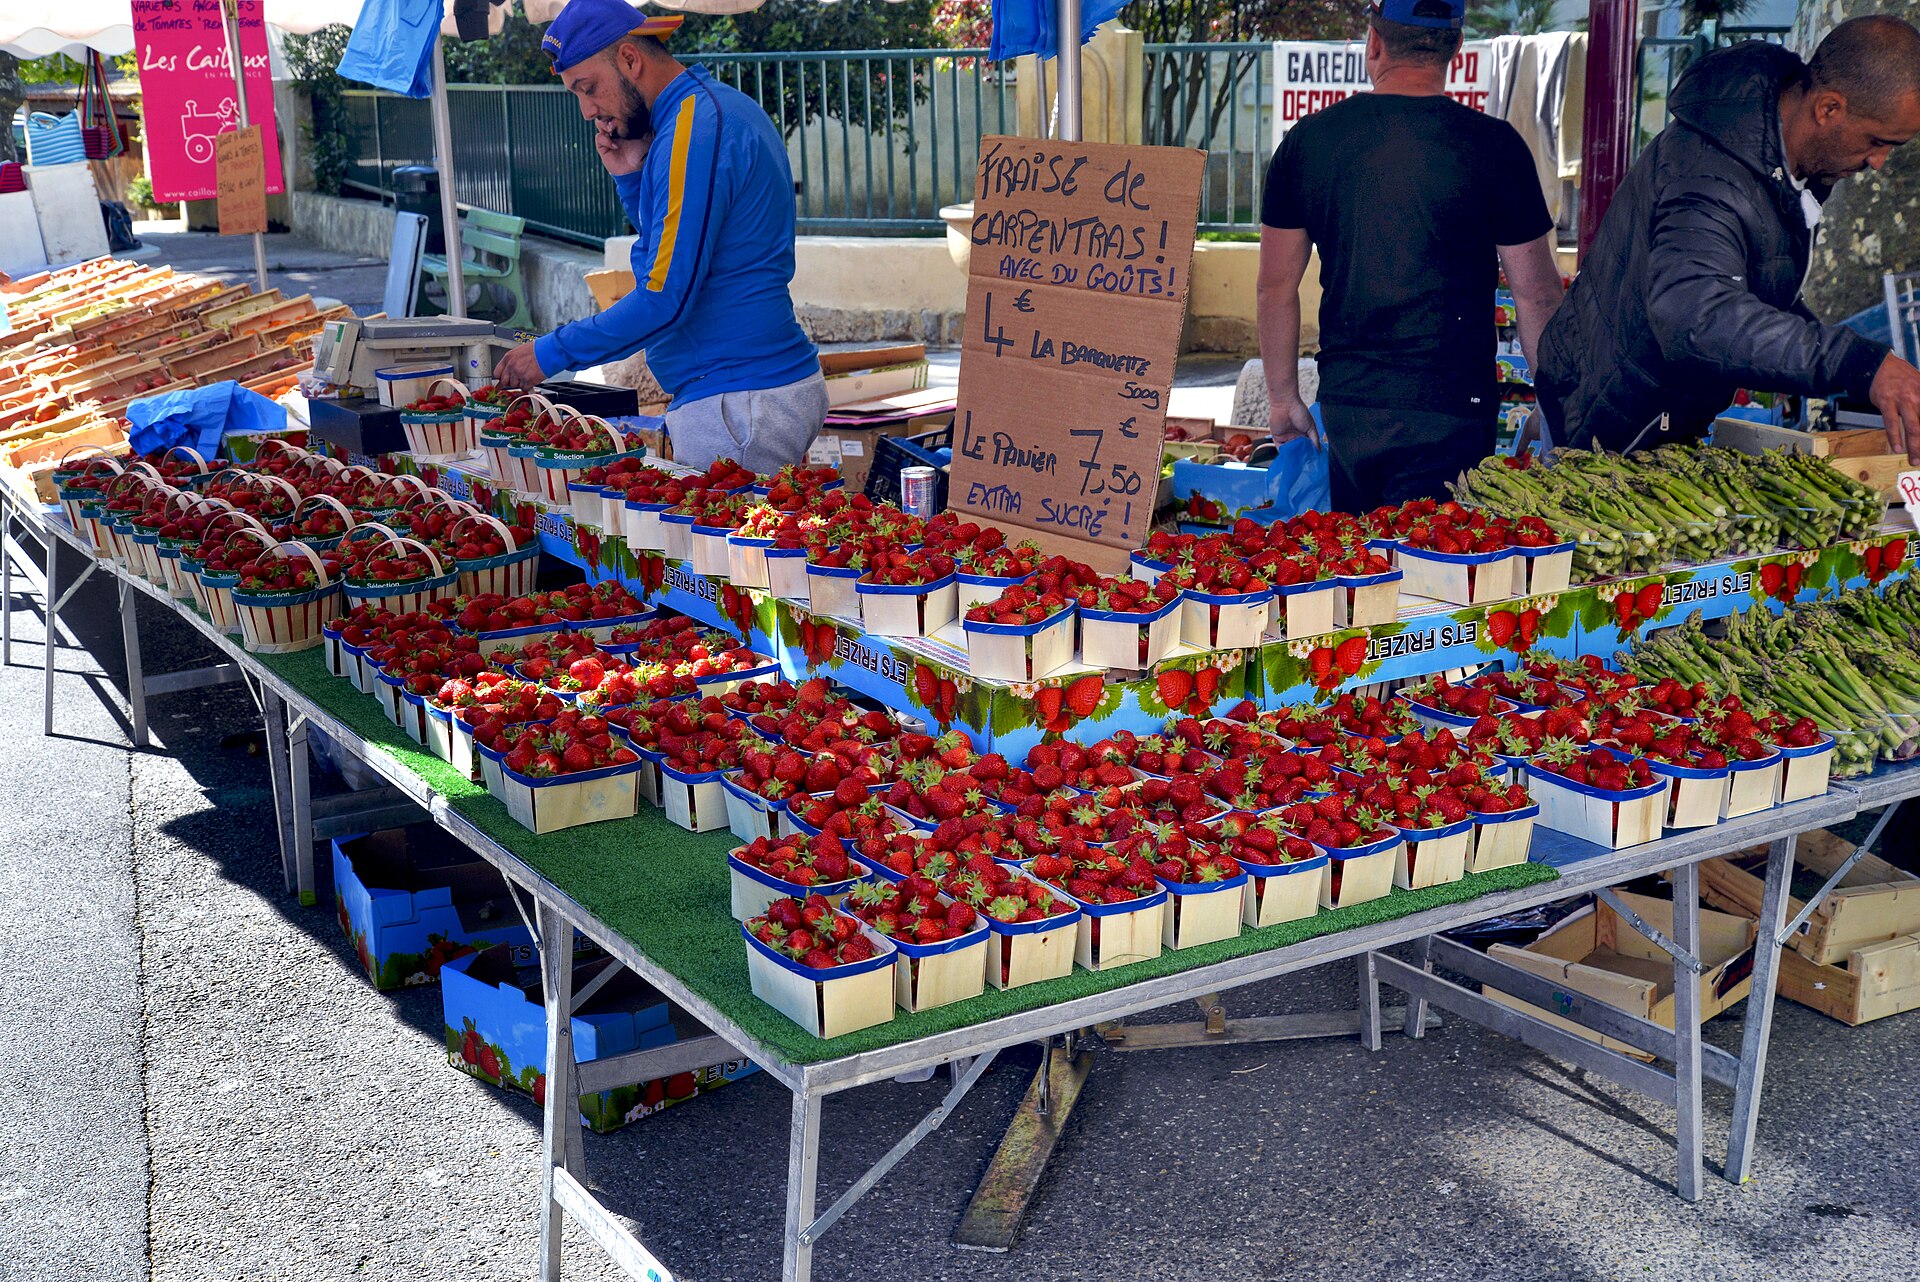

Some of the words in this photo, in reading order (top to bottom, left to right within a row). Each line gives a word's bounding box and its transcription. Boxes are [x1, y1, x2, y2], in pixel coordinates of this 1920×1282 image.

[143, 44, 177, 71] Les
[186, 45, 267, 71] Cailux
[1288, 52, 1371, 83] GAREOU
[220, 71, 262, 79] PRNCE
[1104, 159, 1149, 210] de
[1000, 254, 1043, 280] AVEC
[1050, 264, 1078, 284] DU
[984, 292, 1014, 357] 4
[1031, 330, 1055, 359] LA
[1061, 341, 1151, 376] BARQUETTE
[473, 403, 502, 413] Sélection
[1118, 382, 1160, 410] 500g
[553, 452, 585, 460] Sélection
[1070, 429, 1142, 497] 7,50
[967, 482, 1022, 514] EXTRA
[1036, 498, 1111, 537] SUCRÉ
[559, 523, 574, 544] ETS
[663, 565, 697, 596] FRIZET
[698, 578, 718, 604] ETS
[1660, 578, 1718, 607] FRIZET
[1722, 572, 1753, 596] ETS
[1366, 628, 1437, 662] FRIZET
[1441, 620, 1478, 648] ETS
[833, 634, 879, 674] FRIZET
[881, 653, 908, 687] ETS
[508, 943, 534, 963] TS
